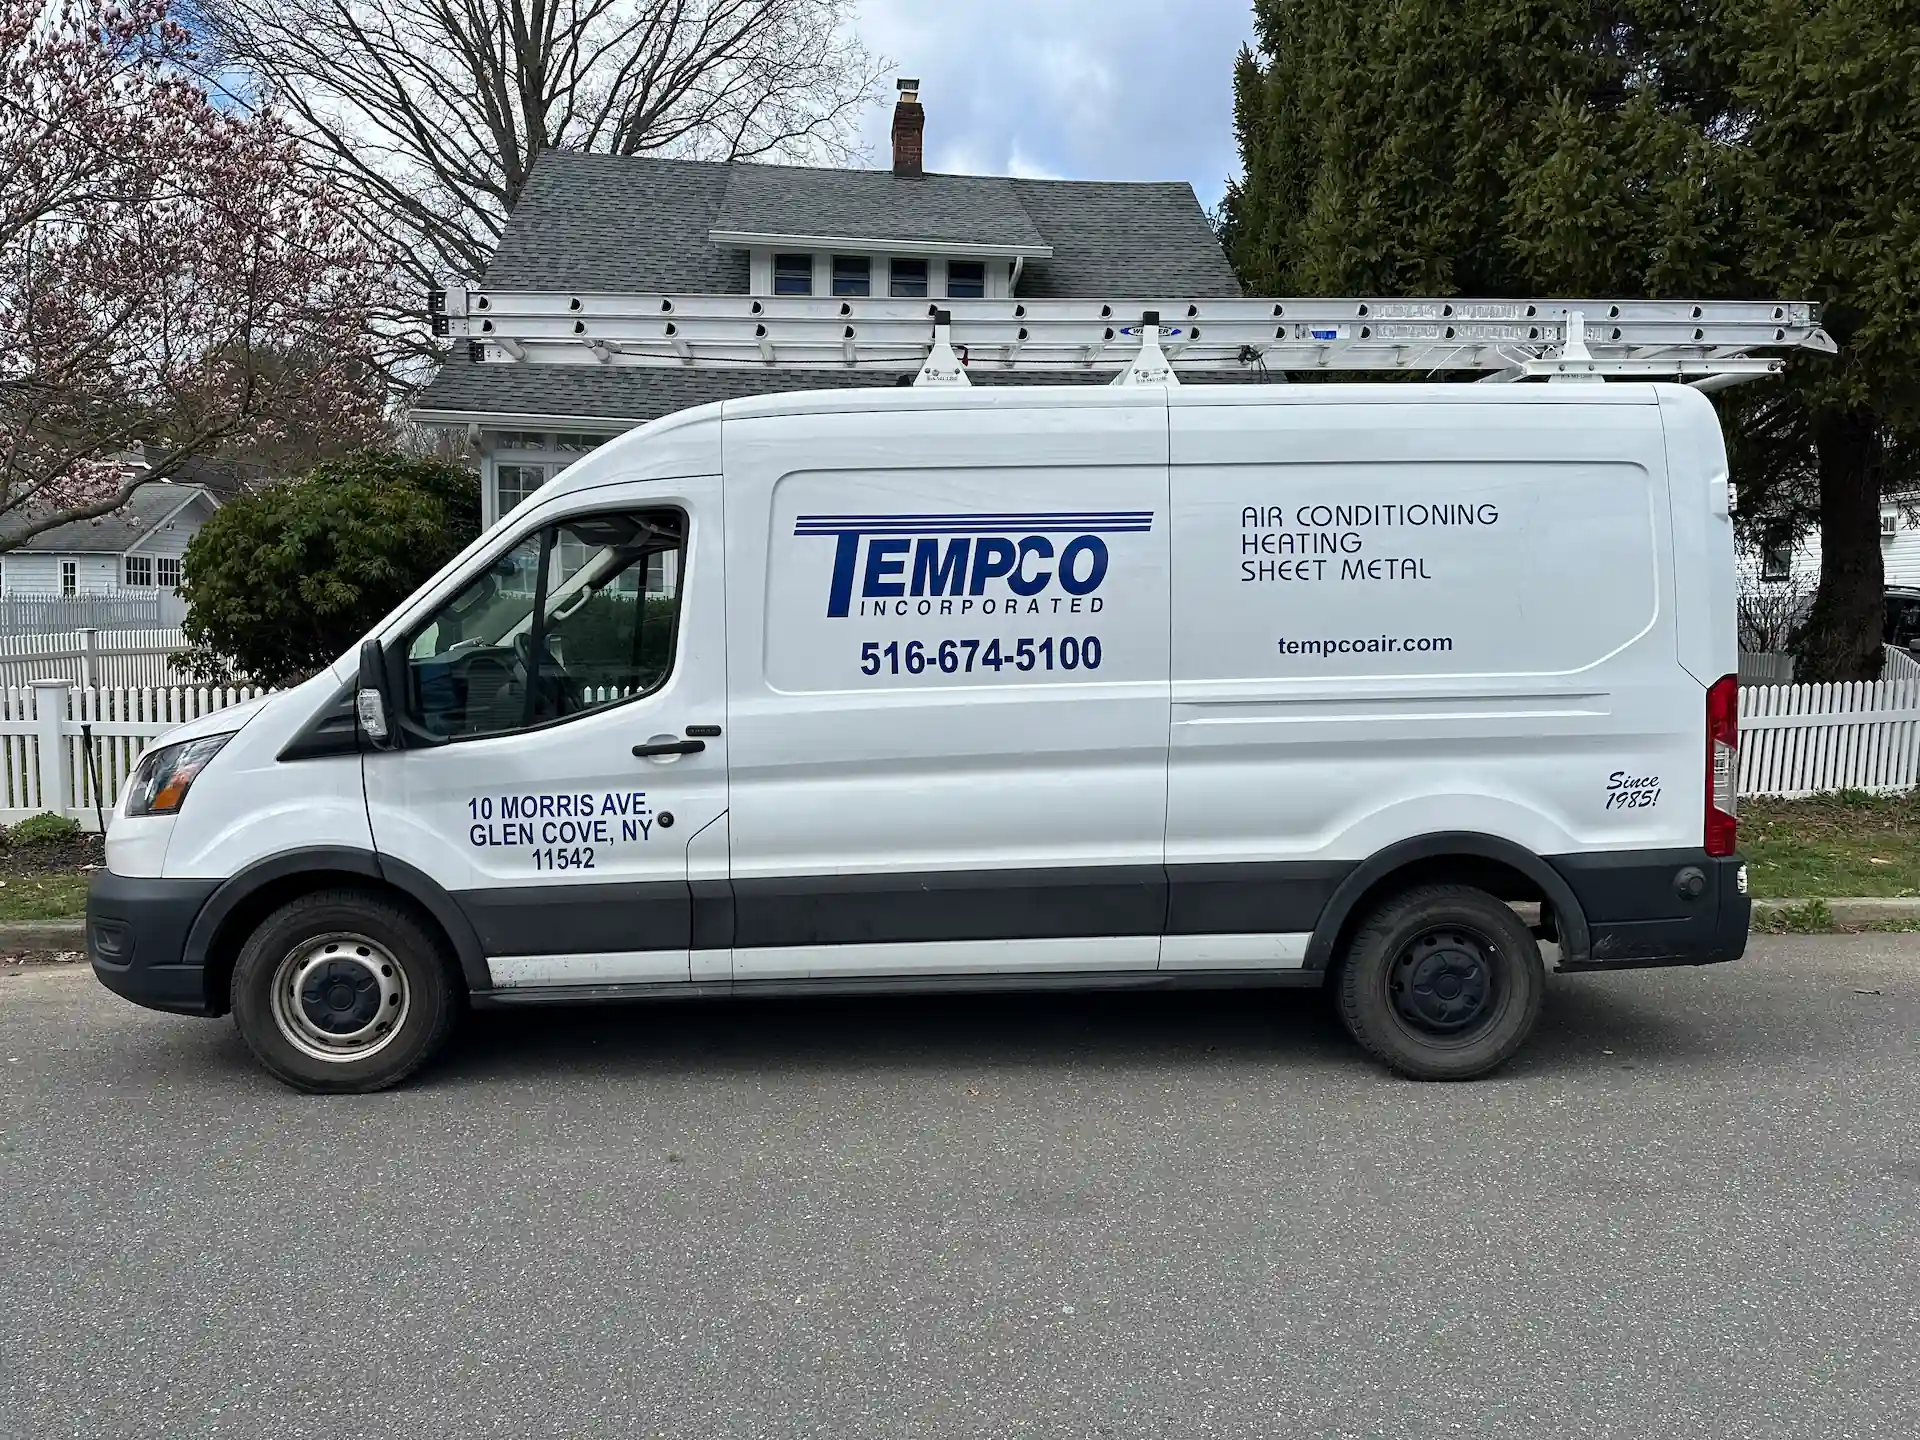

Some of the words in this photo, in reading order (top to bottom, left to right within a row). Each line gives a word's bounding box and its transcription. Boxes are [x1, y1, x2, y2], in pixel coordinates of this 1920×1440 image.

[1133, 327, 1169, 335] WEER
[1242, 506, 1283, 528] AIR
[1296, 503, 1499, 527] CONDITIONING
[1242, 532, 1362, 555] HEATING
[794, 526, 1153, 618] TEMPCO
[1241, 559, 1327, 582] SHEET
[1341, 558, 1432, 580] METAL
[860, 597, 1104, 617] INCORPORATED
[860, 635, 1102, 676] 516-674-5100
[1278, 634, 1453, 658] tempcoair.com
[1606, 771, 1660, 790] Since
[468, 797, 493, 820] 10
[501, 794, 594, 819] MORRIS
[600, 792, 653, 816] AVE.
[1605, 788, 1662, 810] 1985!
[469, 822, 534, 846] GLEN
[542, 820, 614, 846] COVE,
[622, 819, 653, 841] NY
[532, 847, 595, 870] 11542
